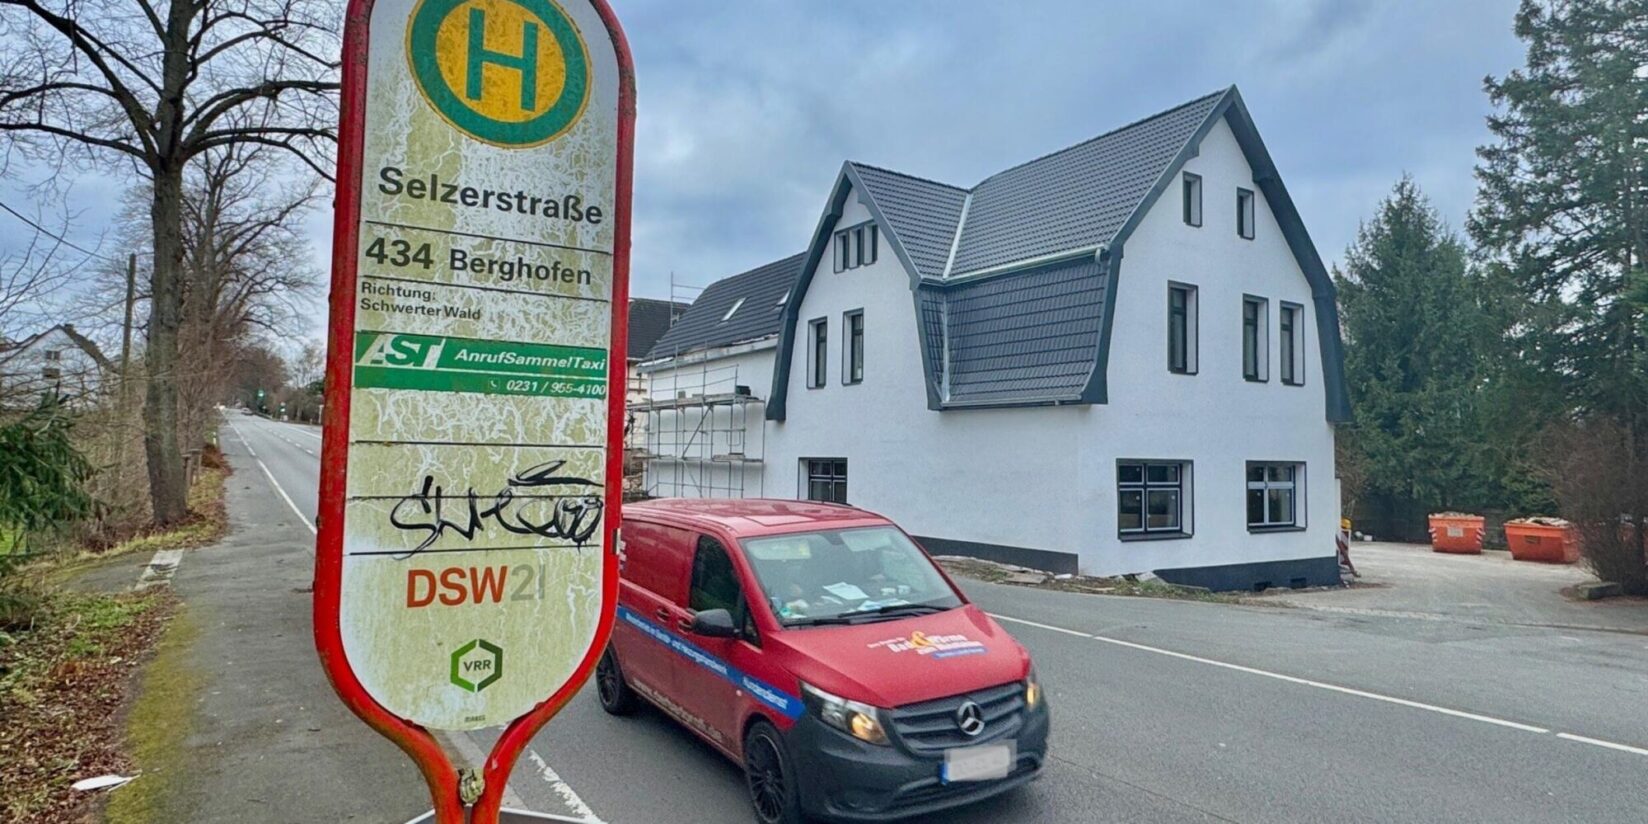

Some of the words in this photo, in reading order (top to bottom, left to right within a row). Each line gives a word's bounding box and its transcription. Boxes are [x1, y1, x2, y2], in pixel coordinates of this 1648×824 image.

[465, 6, 539, 113] H
[378, 166, 604, 225] Selzerstraße
[365, 237, 435, 271] 434
[450, 248, 592, 286] Berghofen
[360, 281, 436, 302] Richtung:
[360, 298, 442, 318] Schwerter
[444, 305, 482, 321] Wald
[454, 348, 607, 371] AnrufSammelTaxi
[506, 379, 538, 392] 0231
[550, 381, 607, 396] 955-4100
[463, 659, 492, 672] VRR
